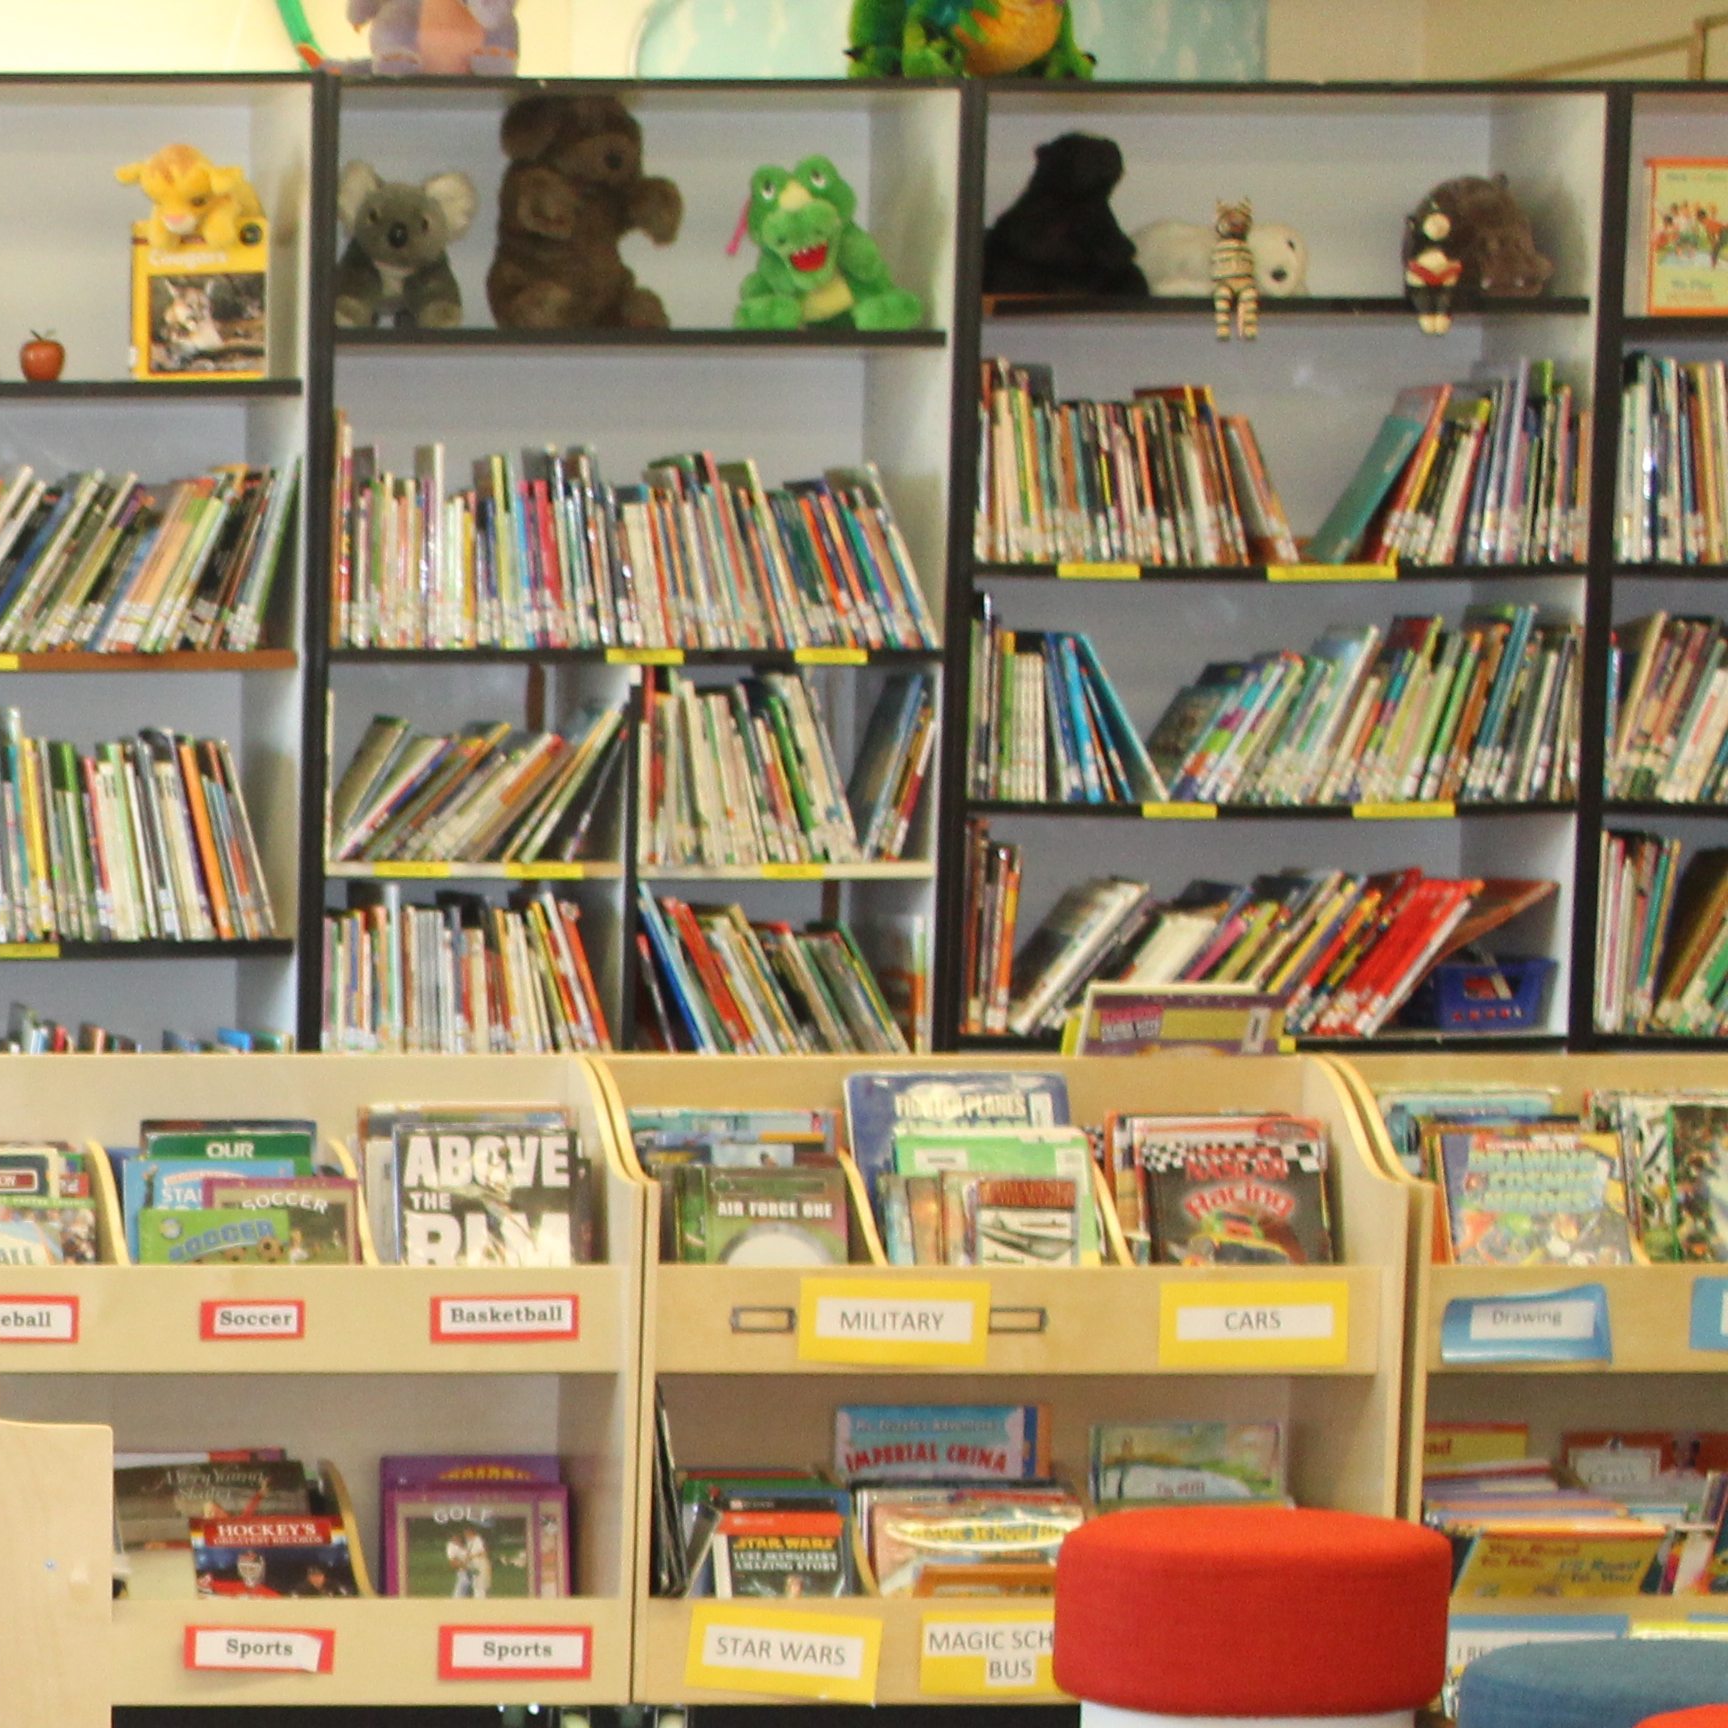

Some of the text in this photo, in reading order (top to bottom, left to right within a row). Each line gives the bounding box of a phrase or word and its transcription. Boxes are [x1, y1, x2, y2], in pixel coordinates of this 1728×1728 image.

[206, 1141, 255, 1159] OUR
[403, 1135, 570, 1188] ABOVE
[1185, 1147, 1288, 1181] NASCAR
[161, 1183, 202, 1203] STA
[242, 1192, 329, 1214] SOCCER
[409, 1192, 452, 1211] THE
[717, 1201, 833, 1218] AIR FORCE ONE
[169, 1219, 275, 1262] SOCCER
[218, 1308, 293, 1328] Soccer
[450, 1305, 564, 1326] Basketball
[840, 1308, 944, 1332] MILITARY
[1224, 1310, 1282, 1331] CARS
[1491, 1307, 1562, 1329] Drawing
[845, 1442, 1007, 1474] IMPERIAL CHINA
[432, 1504, 494, 1524] GOLF
[217, 1522, 317, 1537] HOCKEY'S
[272, 1535, 323, 1544] RECORDS
[733, 1537, 837, 1549] STAR WARS
[734, 1561, 837, 1571] AMAZING STORY
[716, 1636, 847, 1667] STAR WARS
[928, 1630, 1053, 1653] MAGIC SCH
[988, 1659, 1033, 1680] BUS
